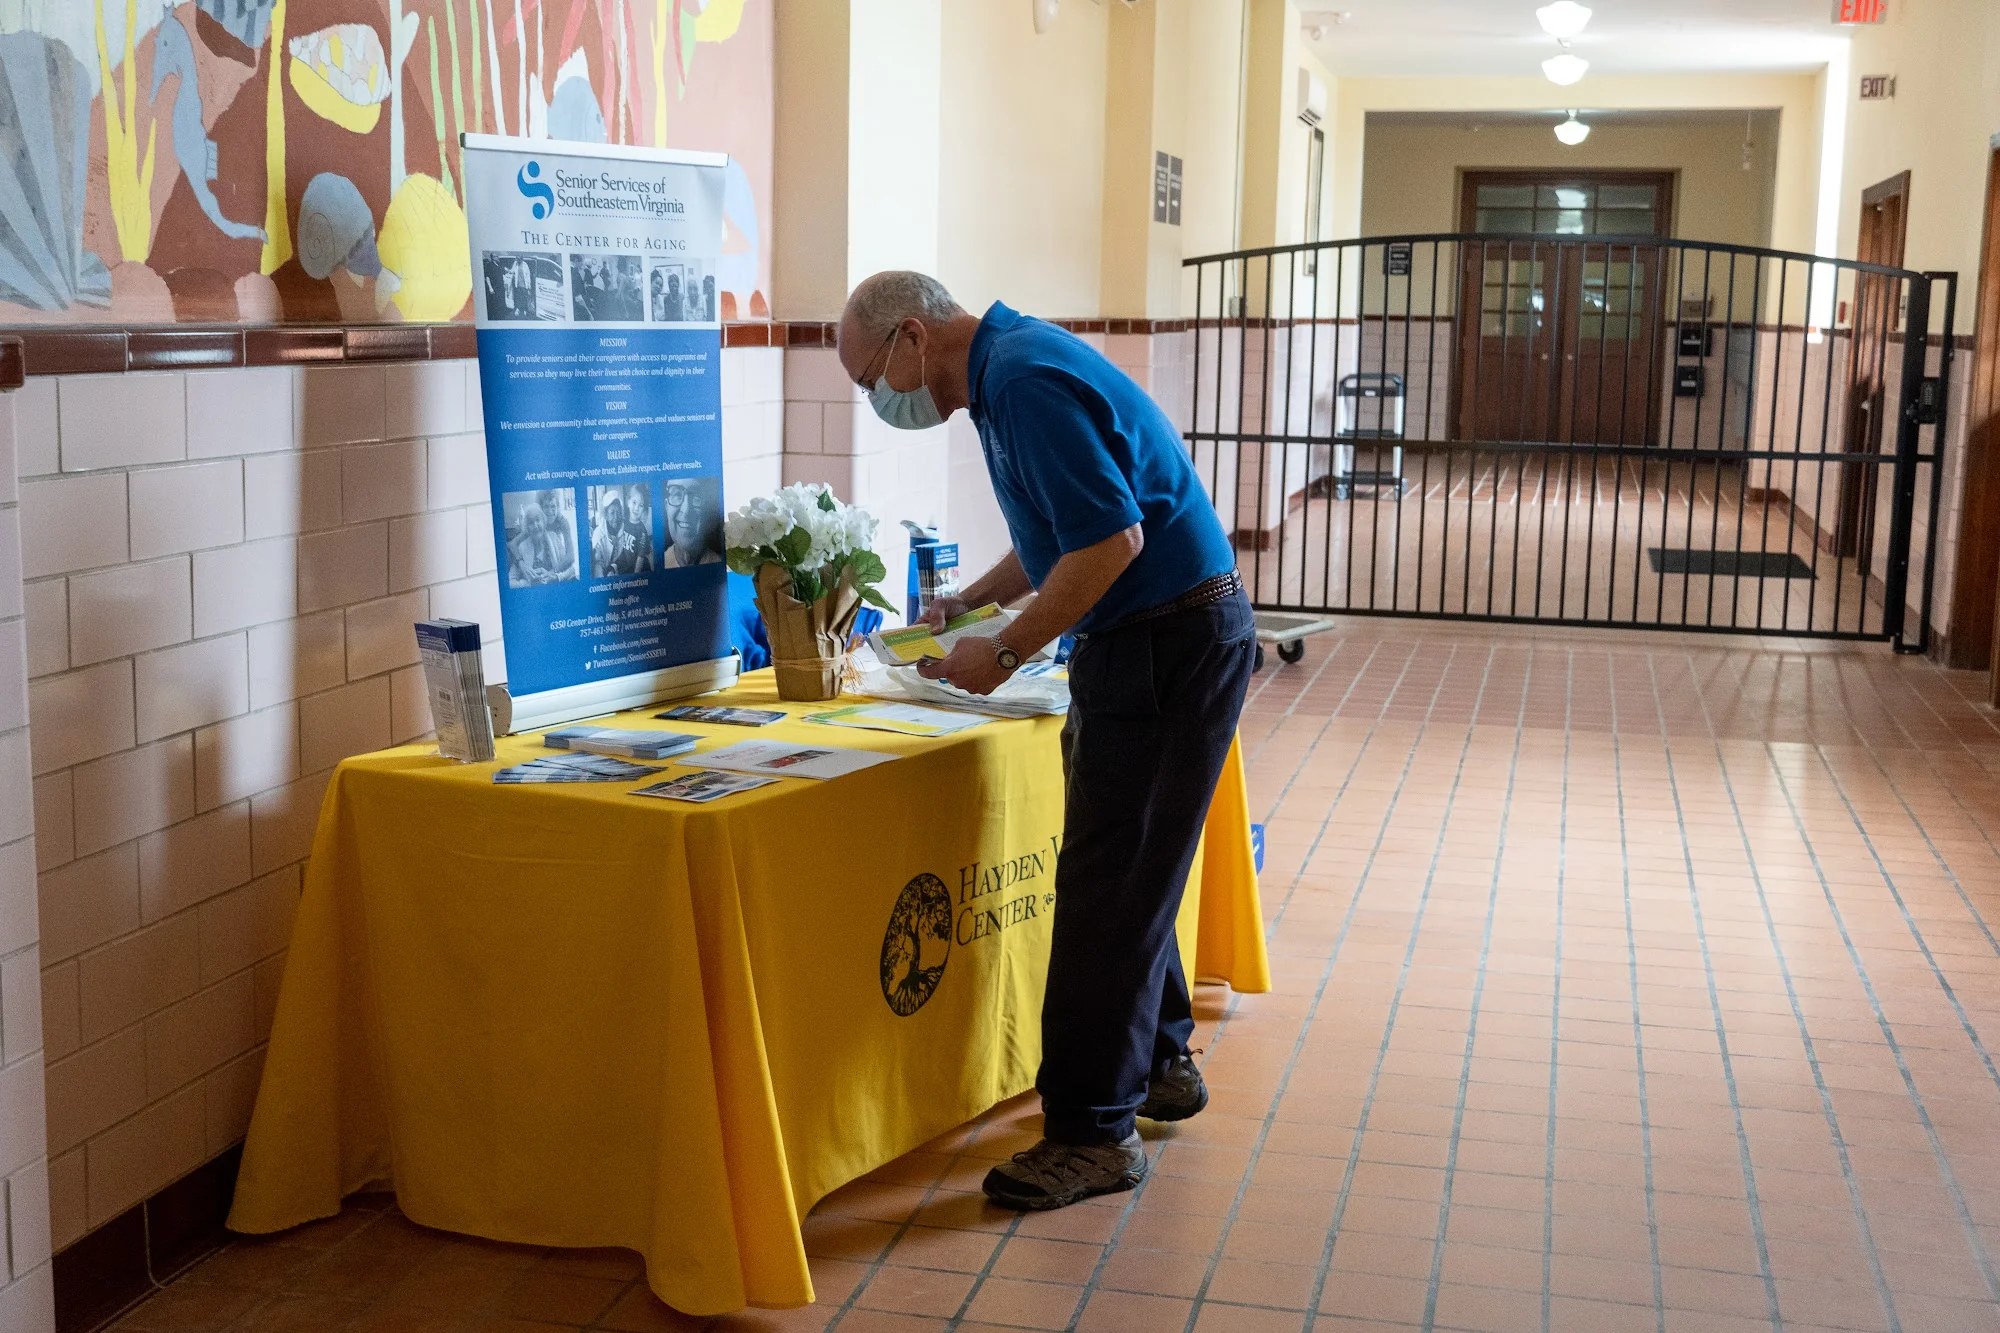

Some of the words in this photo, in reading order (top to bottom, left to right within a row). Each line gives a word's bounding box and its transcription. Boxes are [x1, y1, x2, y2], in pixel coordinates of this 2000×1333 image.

[1860, 77, 1887, 97] EXIT
[556, 169, 597, 190] Senior
[601, 172, 650, 193] Services
[653, 177, 666, 194] of
[557, 189, 638, 211] Southeastern
[638, 194, 684, 217] Virginia
[521, 230, 549, 245] THE
[555, 232, 610, 248] CENTER
[616, 237, 639, 249] FOR
[644, 237, 686, 251] AGING
[600, 337, 627, 347] MISSION
[506, 354, 515, 363] To
[516, 353, 540, 365] provide
[541, 354, 563, 363] seniors
[564, 353, 578, 363] and
[578, 353, 594, 362] their
[596, 353, 626, 363] caregivers
[627, 352, 640, 361] with
[668, 353, 696, 362] programs
[696, 352, 707, 361] and
[509, 369, 536, 379] services
[545, 369, 558, 380] they
[559, 370, 573, 380] may
[574, 369, 588, 377] live
[588, 368, 604, 377] their
[604, 368, 618, 377] lives
[618, 367, 631, 376] with
[631, 367, 650, 376] choice
[650, 367, 663, 375] and
[664, 366, 685, 378] dignity
[685, 367, 691, 375] in
[692, 366, 705, 375] their
[594, 382, 632, 392] communities.
[605, 401, 627, 411] VISION
[500, 421, 512, 430] We
[513, 420, 539, 430] envision
[546, 419, 581, 429] community
[583, 417, 597, 427] that
[628, 416, 653, 426] respects,
[654, 413, 667, 423] and
[667, 413, 686, 423] values
[686, 413, 705, 421] seniors
[705, 411, 716, 420] and
[593, 431, 607, 441] their
[608, 431, 638, 441] caregivers.
[606, 449, 630, 460] VALUES
[525, 471, 536, 481] Act
[537, 470, 550, 480] with
[580, 466, 601, 477] Create
[617, 464, 638, 474] Exhibit
[662, 461, 682, 471] Deliver
[589, 583, 612, 594] contact
[612, 578, 649, 592] information
[609, 597, 624, 606] Main
[623, 595, 640, 607] office
[550, 618, 566, 630] 6350
[566, 616, 588, 628] Center
[957, 849, 1047, 906] HAYDEN
[956, 894, 1038, 946] CENTER
